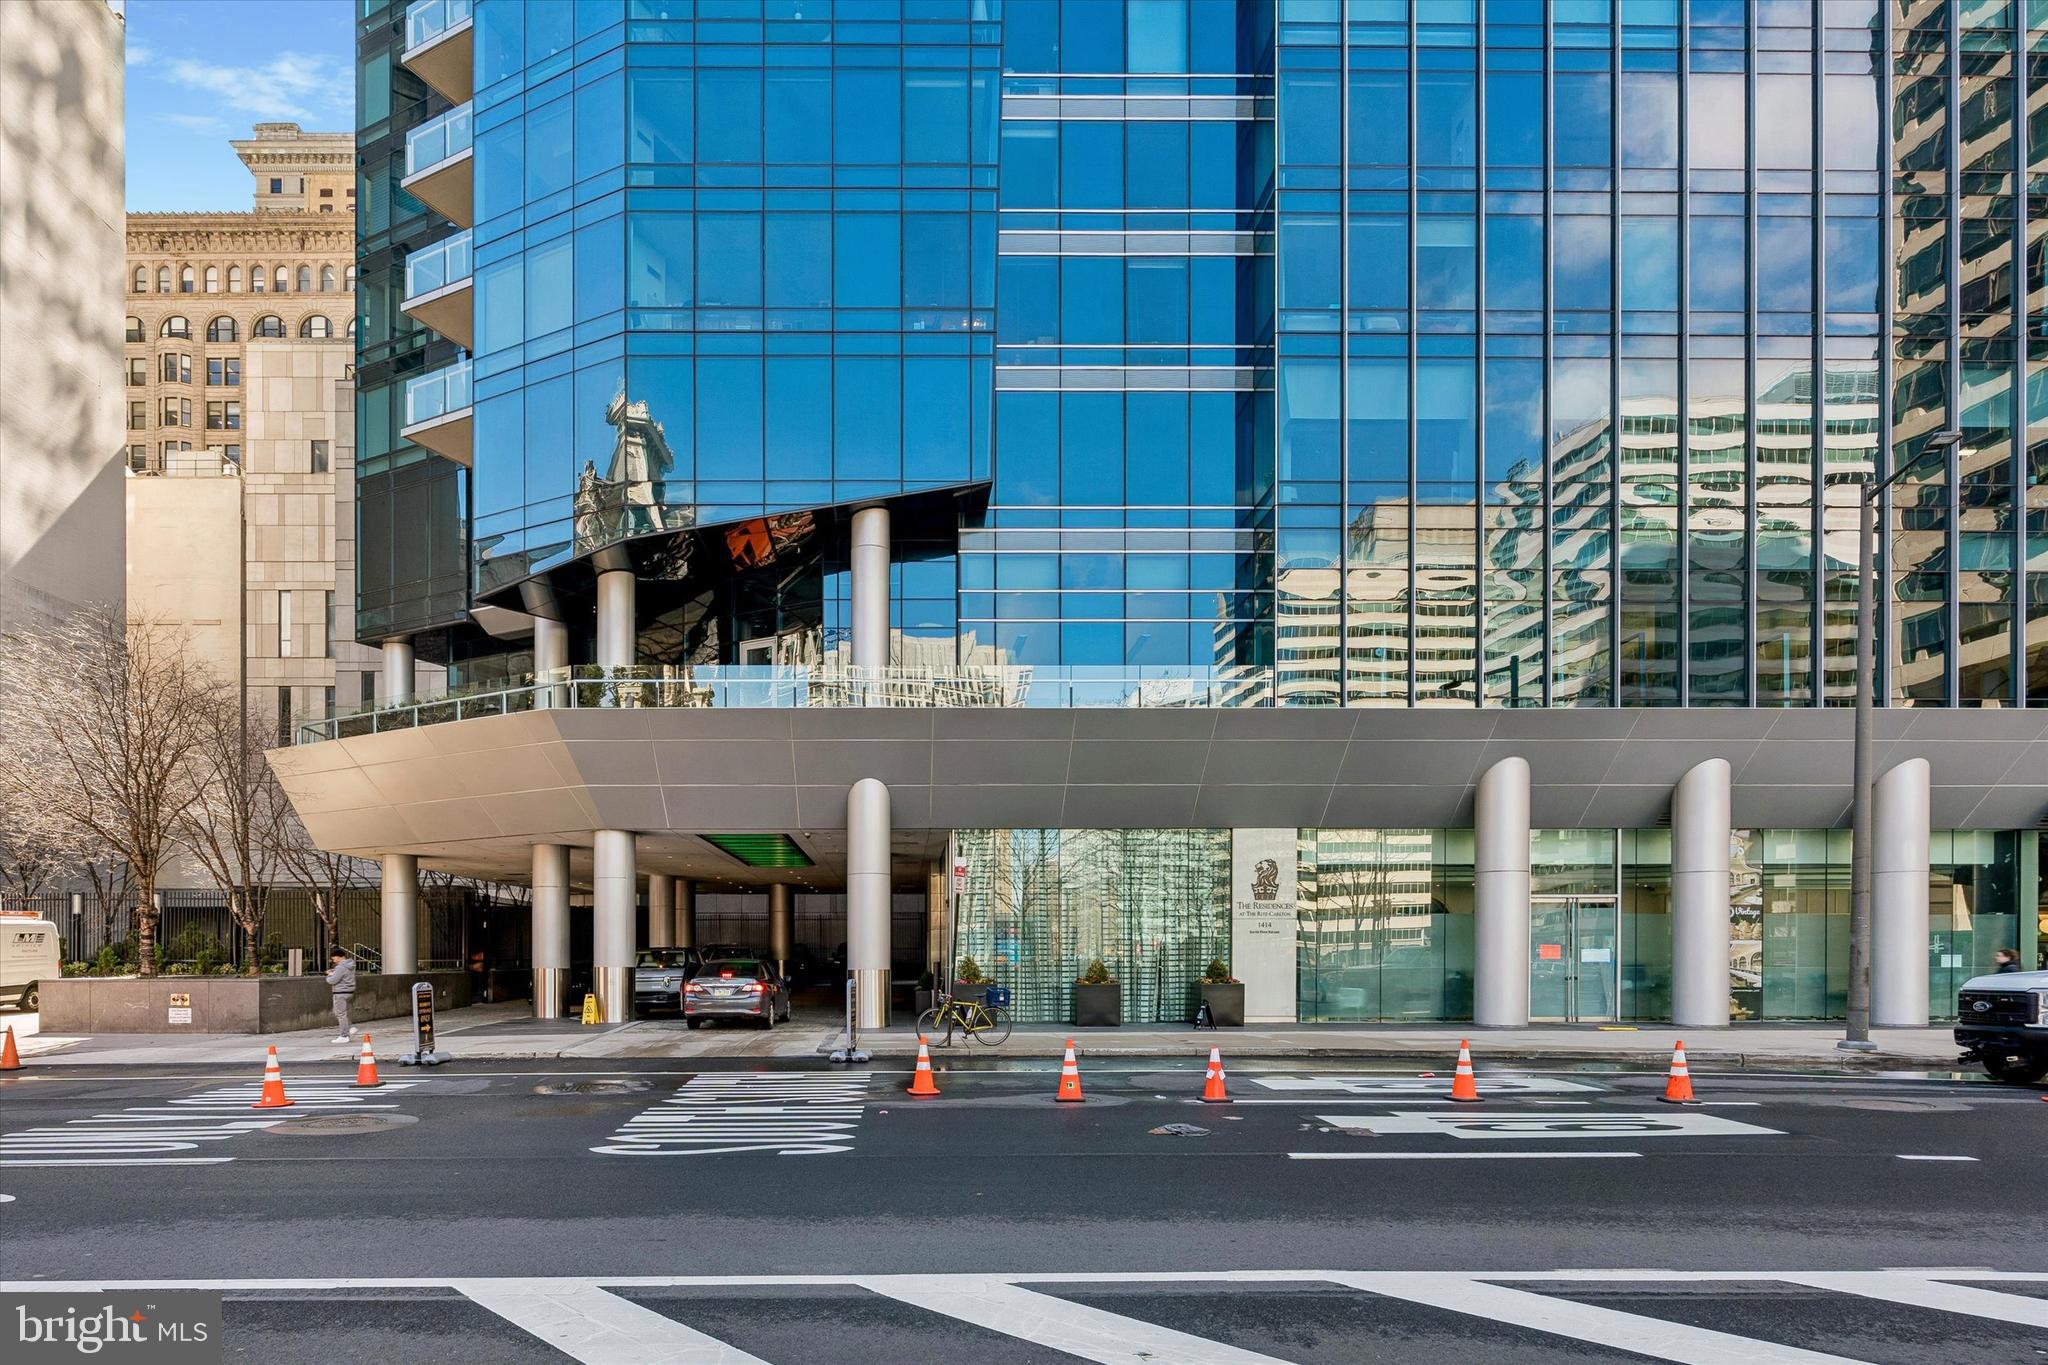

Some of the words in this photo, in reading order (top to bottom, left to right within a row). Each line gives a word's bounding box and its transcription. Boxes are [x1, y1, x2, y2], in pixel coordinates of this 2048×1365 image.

[1236, 901, 1251, 910] THE
[1253, 901, 1294, 910] RESIDENCES
[1735, 907, 1760, 919] Vintage
